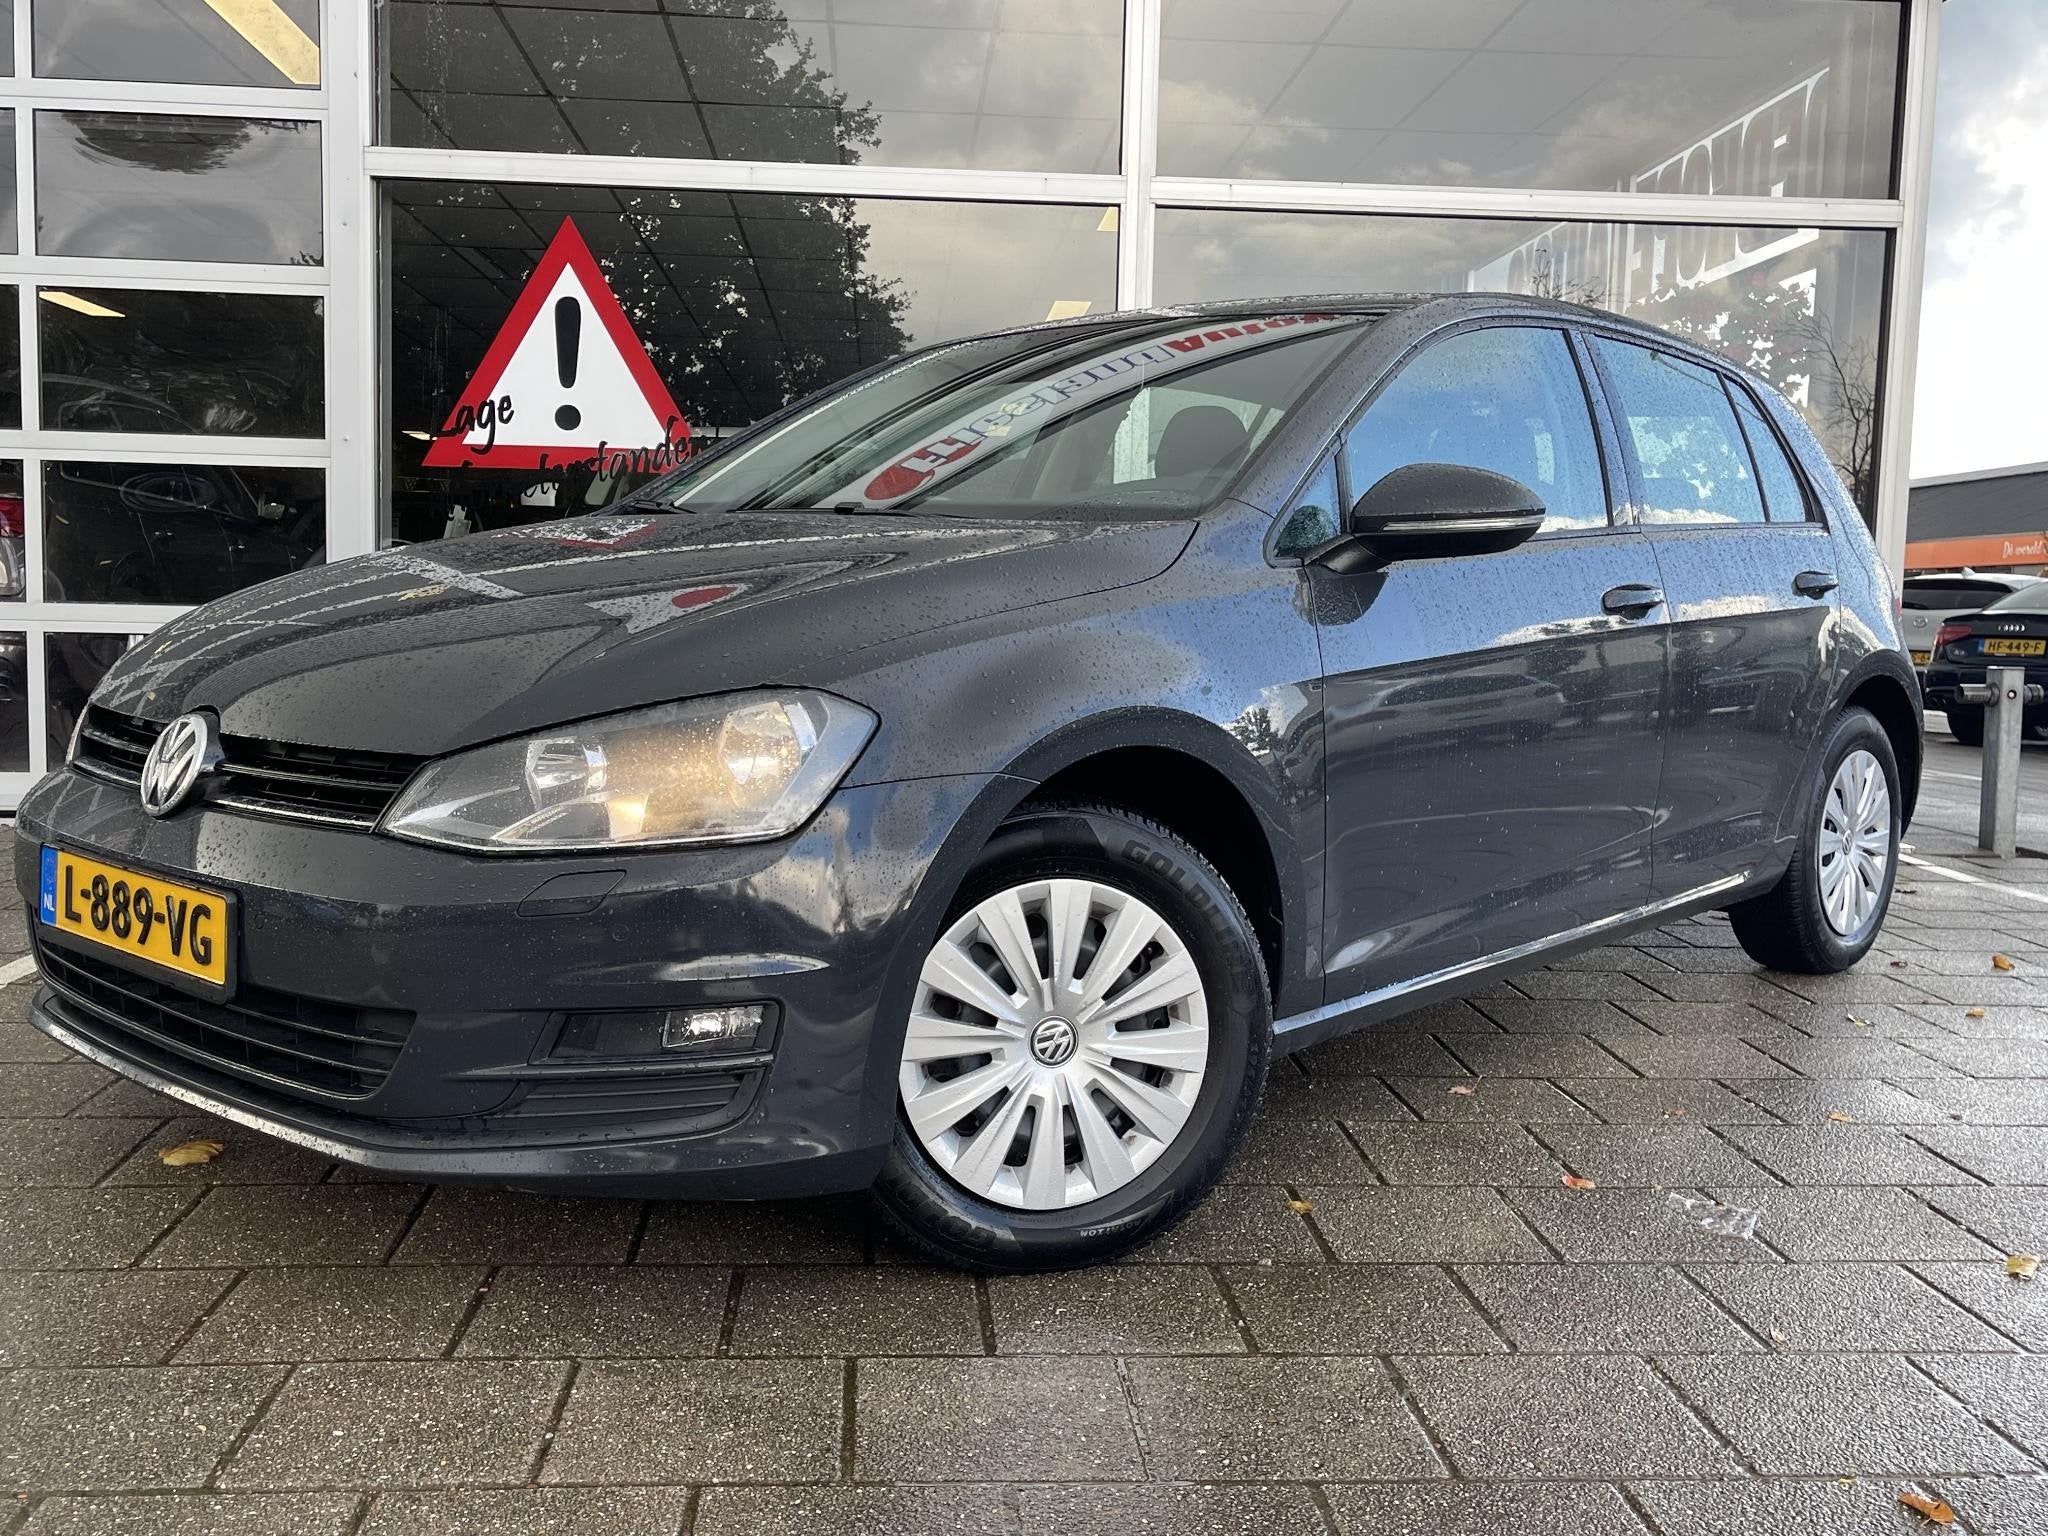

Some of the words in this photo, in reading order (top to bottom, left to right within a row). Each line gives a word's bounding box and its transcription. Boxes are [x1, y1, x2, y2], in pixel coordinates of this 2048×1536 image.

[1987, 640, 2041, 652] HF-449-F
[43, 892, 55, 911] NL
[64, 864, 212, 966] L-889-VG
